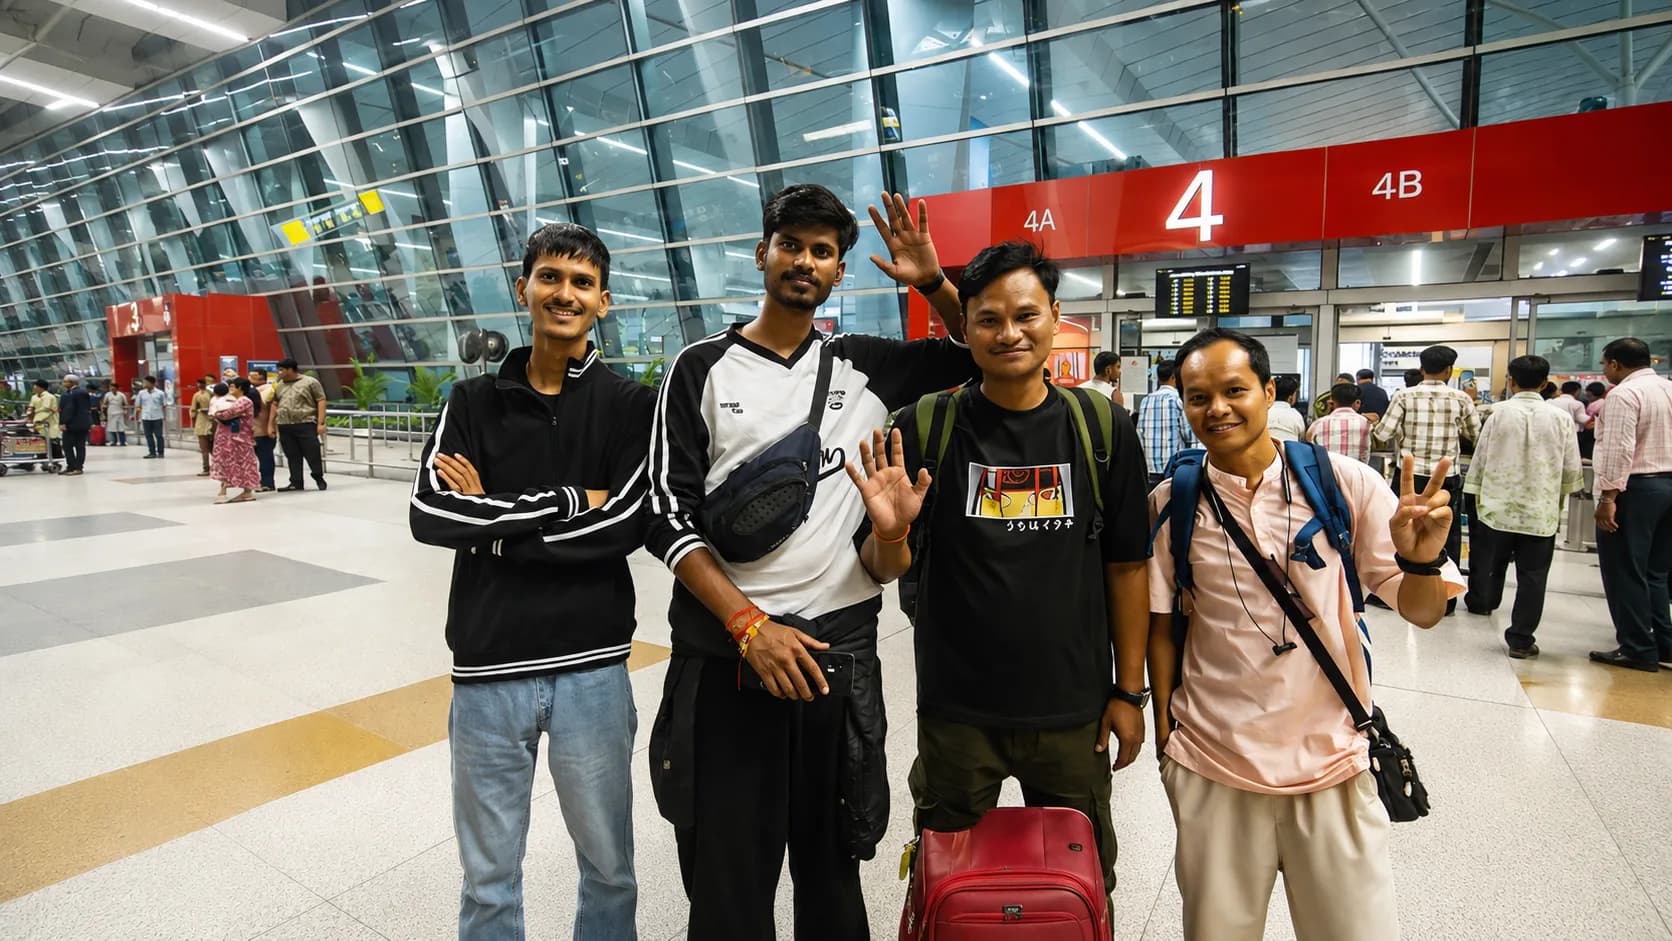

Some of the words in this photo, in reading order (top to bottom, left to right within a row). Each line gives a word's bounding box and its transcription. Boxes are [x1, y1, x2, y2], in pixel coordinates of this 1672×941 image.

[1372, 169, 1423, 200] 4B
[1023, 208, 1057, 233] 4A
[1165, 169, 1224, 242] 4
[130, 301, 141, 333] 3
